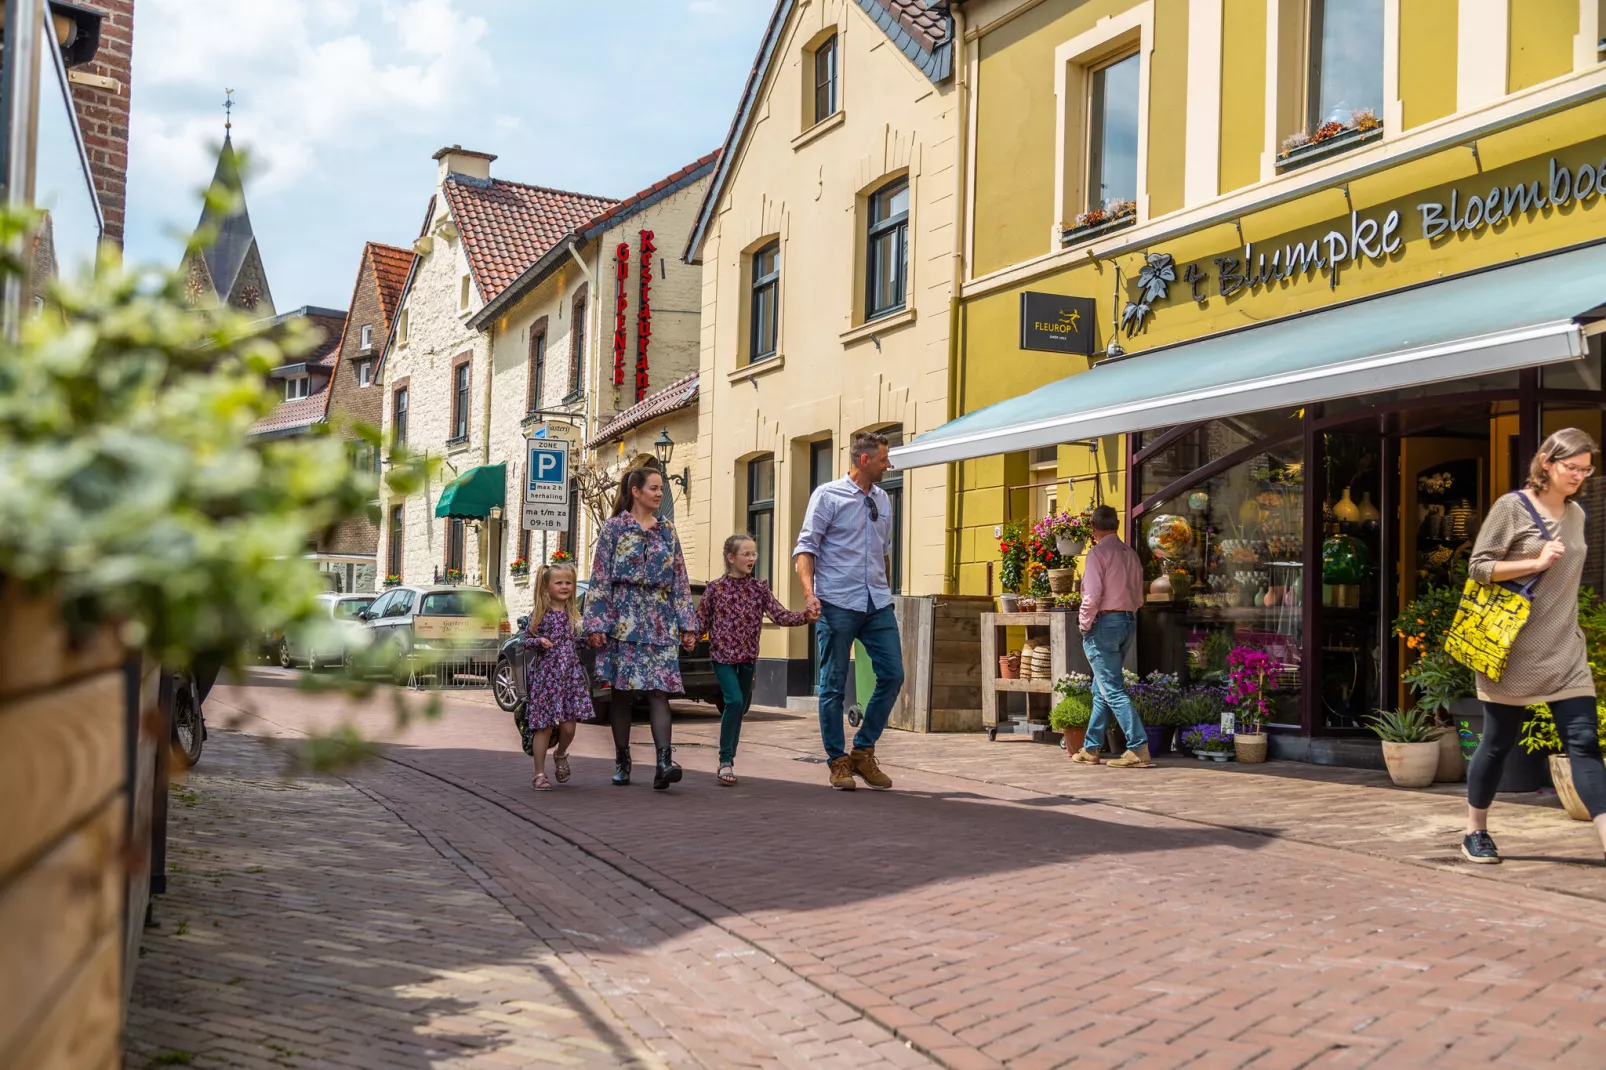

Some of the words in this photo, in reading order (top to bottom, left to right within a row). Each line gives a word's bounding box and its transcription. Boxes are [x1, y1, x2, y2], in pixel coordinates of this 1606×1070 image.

[1213, 210, 1402, 292] Blumpke
[614, 242, 630, 385] GULPENER
[635, 229, 657, 402] Restaurant
[1034, 321, 1072, 333] FLEUROP
[538, 441, 558, 449] ZONE
[538, 453, 557, 479] P
[530, 492, 563, 501] herhaling
[540, 508, 555, 516] t/m
[530, 519, 554, 527] 09-18
